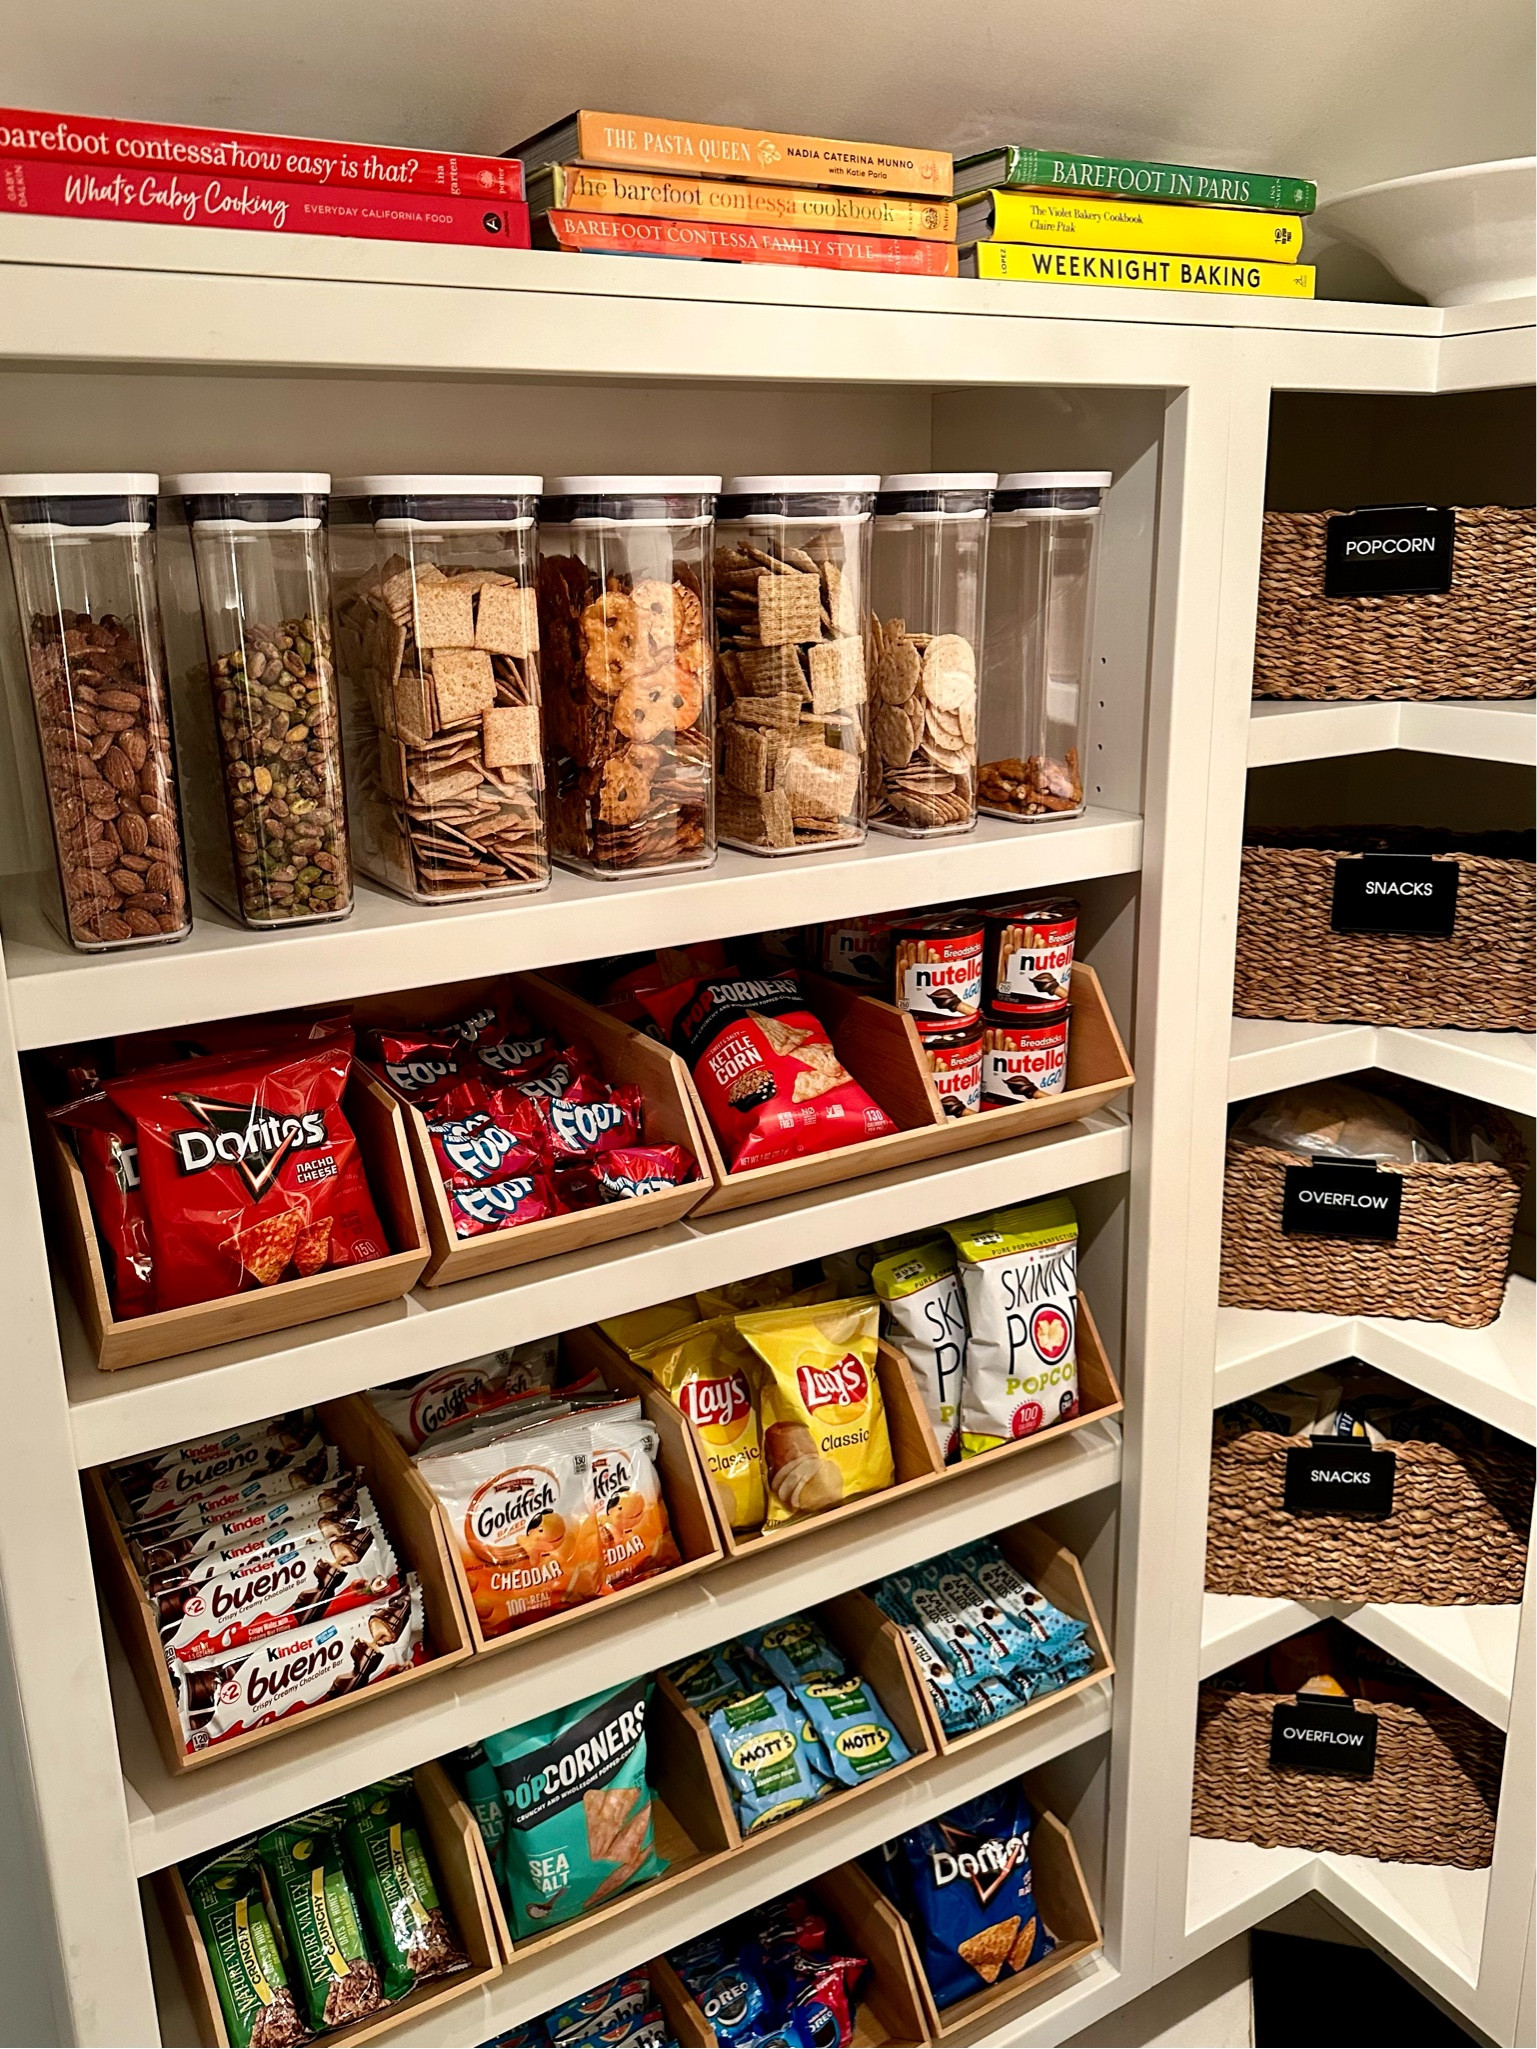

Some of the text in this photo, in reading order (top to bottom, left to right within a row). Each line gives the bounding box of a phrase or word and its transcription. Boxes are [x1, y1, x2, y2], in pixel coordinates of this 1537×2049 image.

[604, 127, 751, 163] THE PASTA QUEEN
[787, 147, 914, 169] NADIA CATERINA MUNNO
[116, 137, 227, 166] contessa
[231, 141, 281, 171] how
[286, 153, 337, 184] easy
[341, 153, 358, 179] is
[363, 155, 418, 184] that?
[434, 164, 445, 185] ina
[829, 166, 845, 175] with
[846, 168, 866, 177] Katie
[449, 157, 461, 196] garten
[1051, 160, 1166, 192] BAREFOOT
[1169, 173, 1195, 196] IN
[1196, 177, 1250, 202] PARIS
[65, 173, 289, 229] What's Gaby Cooking
[572, 175, 895, 222] the barefoot contessa cookbook
[304, 203, 453, 224] EVERYDAY CALIFORNIA FOOD
[1030, 205, 1143, 224] The Violet Bakery Cookbook
[1030, 219, 1076, 232] Claire Ptak
[564, 218, 874, 259] BAREFOOT CONTESSA FAMILY STYLE
[1032, 253, 1261, 288] WEEKNIGHT BAKING
[1345, 537, 1436, 556] POPCORN
[1365, 880, 1434, 896] SNACKS
[1020, 944, 1073, 971] nutell
[708, 1035, 755, 1072] KETTLE
[1020, 1035, 1062, 1048] Breadsticks
[715, 1047, 763, 1085] CORN
[993, 1049, 1064, 1073] nutella
[552, 1103, 621, 1149] FOOT
[866, 1109, 884, 1121] 130
[177, 1111, 324, 1172] Doritos
[296, 1156, 334, 1173] NACHO
[297, 1164, 338, 1184] CHEESE
[457, 1177, 533, 1222] FOOT
[1298, 1189, 1389, 1210] OVERFLOW
[354, 1241, 376, 1258] 150
[991, 1246, 1011, 1255] PURE
[801, 1359, 862, 1407] Lay's
[1005, 1362, 1076, 1396] POPCO
[688, 1376, 746, 1426] Lay's
[1020, 1405, 1039, 1423] 100
[180, 1443, 219, 1460] Kinder
[821, 1428, 870, 1452] Classic
[176, 1449, 258, 1492] bueno
[573, 1455, 586, 1465] 130
[708, 1446, 760, 1473] Classic
[1310, 1469, 1371, 1484] SNACKS
[198, 1493, 239, 1513] Kinder
[477, 1482, 554, 1538] Goldfish
[222, 1514, 266, 1536] Kinder
[220, 1540, 265, 1562] Kinder
[230, 1560, 275, 1580] Kinder
[490, 1559, 564, 1592] CHEDDAR
[994, 1563, 1023, 1595] CHEWY
[212, 1560, 306, 1618] bueno
[218, 1576, 307, 1624] Crispy Creamy Chocolate Bar
[949, 1588, 970, 1611] SOFT
[954, 1576, 983, 1607] CHEWY
[990, 1576, 1012, 1600] SOFT
[921, 1601, 943, 1625] SOFT
[927, 1592, 955, 1623] CHEWY
[977, 1623, 1007, 1658] KIRKLAND
[1019, 1610, 1048, 1644] KIRKLAND
[266, 1638, 313, 1662] Kinder
[945, 1639, 976, 1675] KIRKLAND
[247, 1640, 343, 1706] bueno
[252, 1658, 344, 1713] Crispy Creamy Chocolate Bar
[193, 1733, 208, 1745] 120
[740, 1735, 793, 1766] MOTT'S
[842, 1730, 886, 1751] MOTT'S
[1283, 1727, 1364, 1747] OVERFLOW
[504, 1700, 646, 1810] POPCORNERS
[516, 1773, 599, 1823] CRUNCHY AND WHOLESOME
[370, 1836, 397, 1883] VALLEY
[528, 1852, 570, 1878] SEA
[532, 1869, 571, 1893] SALT
[327, 1891, 342, 1917] HONEY
[288, 1875, 336, 1983] NATURE VALLEY
[313, 1894, 337, 1956] CRUNCHY
[336, 1926, 349, 1946] OATS
[212, 1912, 262, 2014] NATURE VALLEY
[237, 1924, 262, 1986] CRUNCHY
[703, 1981, 749, 2018] OREO
